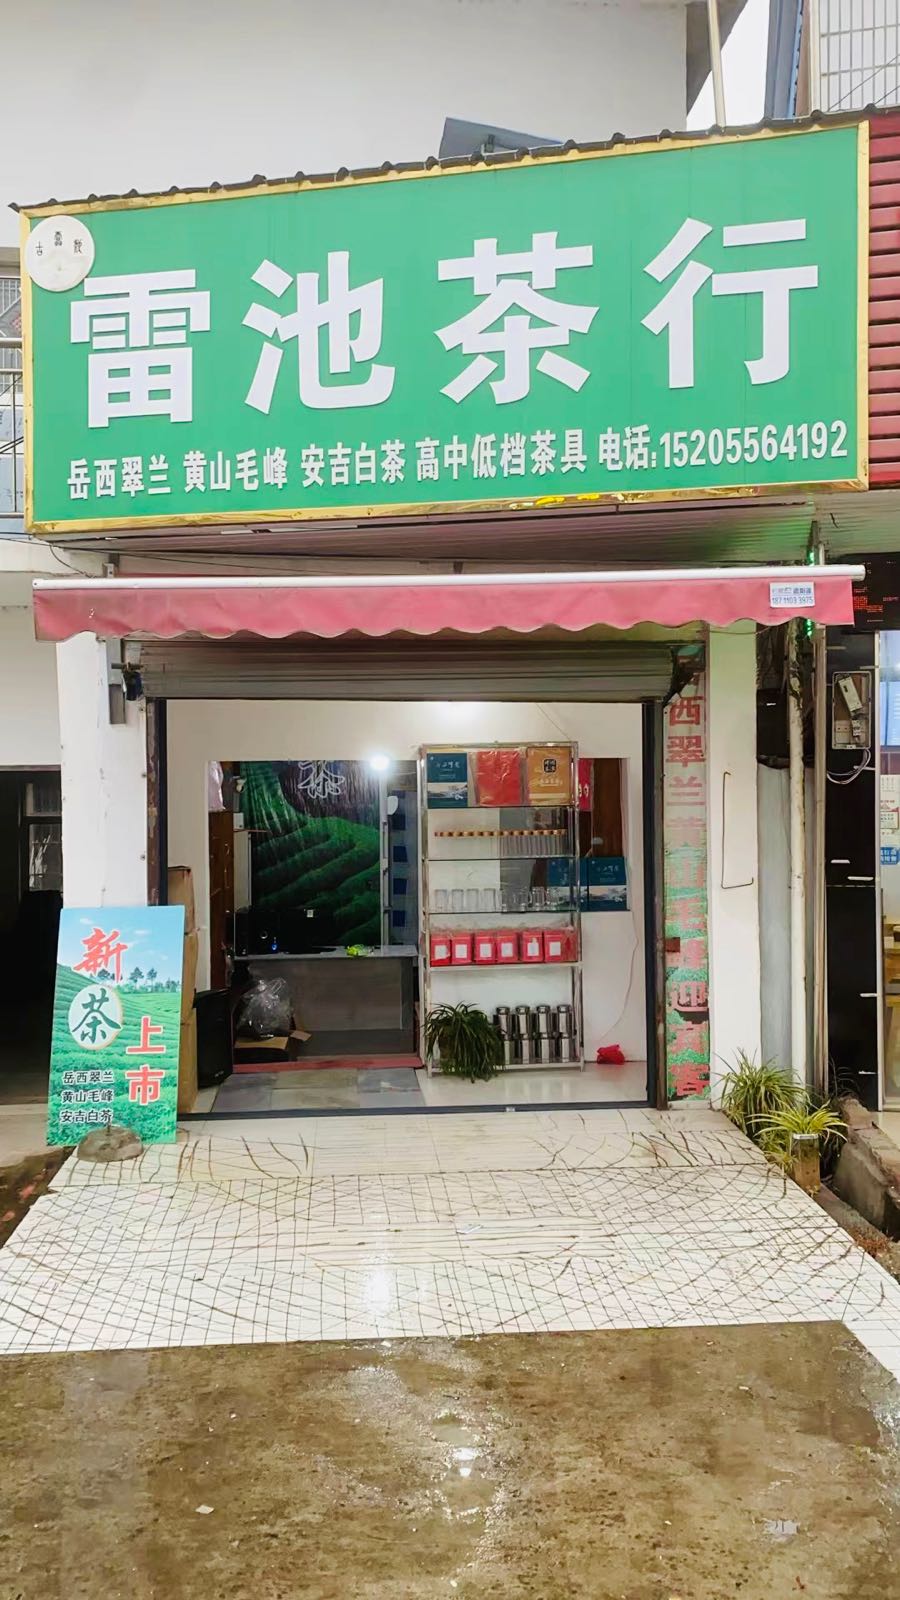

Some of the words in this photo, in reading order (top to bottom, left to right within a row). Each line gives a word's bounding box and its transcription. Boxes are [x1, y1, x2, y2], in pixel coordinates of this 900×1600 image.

[70, 217, 819, 428] 雷池茶行
[67, 454, 172, 500] 岳西翠兰
[183, 446, 289, 494] 黄山毛峰
[301, 438, 406, 487] 安吉白茶
[415, 428, 588, 481] 高中低档茶具
[62, 1070, 115, 1085] 岳西翠兰
[125, 1015, 166, 1106] 上市
[60, 1090, 114, 1104] 黄山毛峰
[60, 1109, 113, 1125] 安吉白茶
